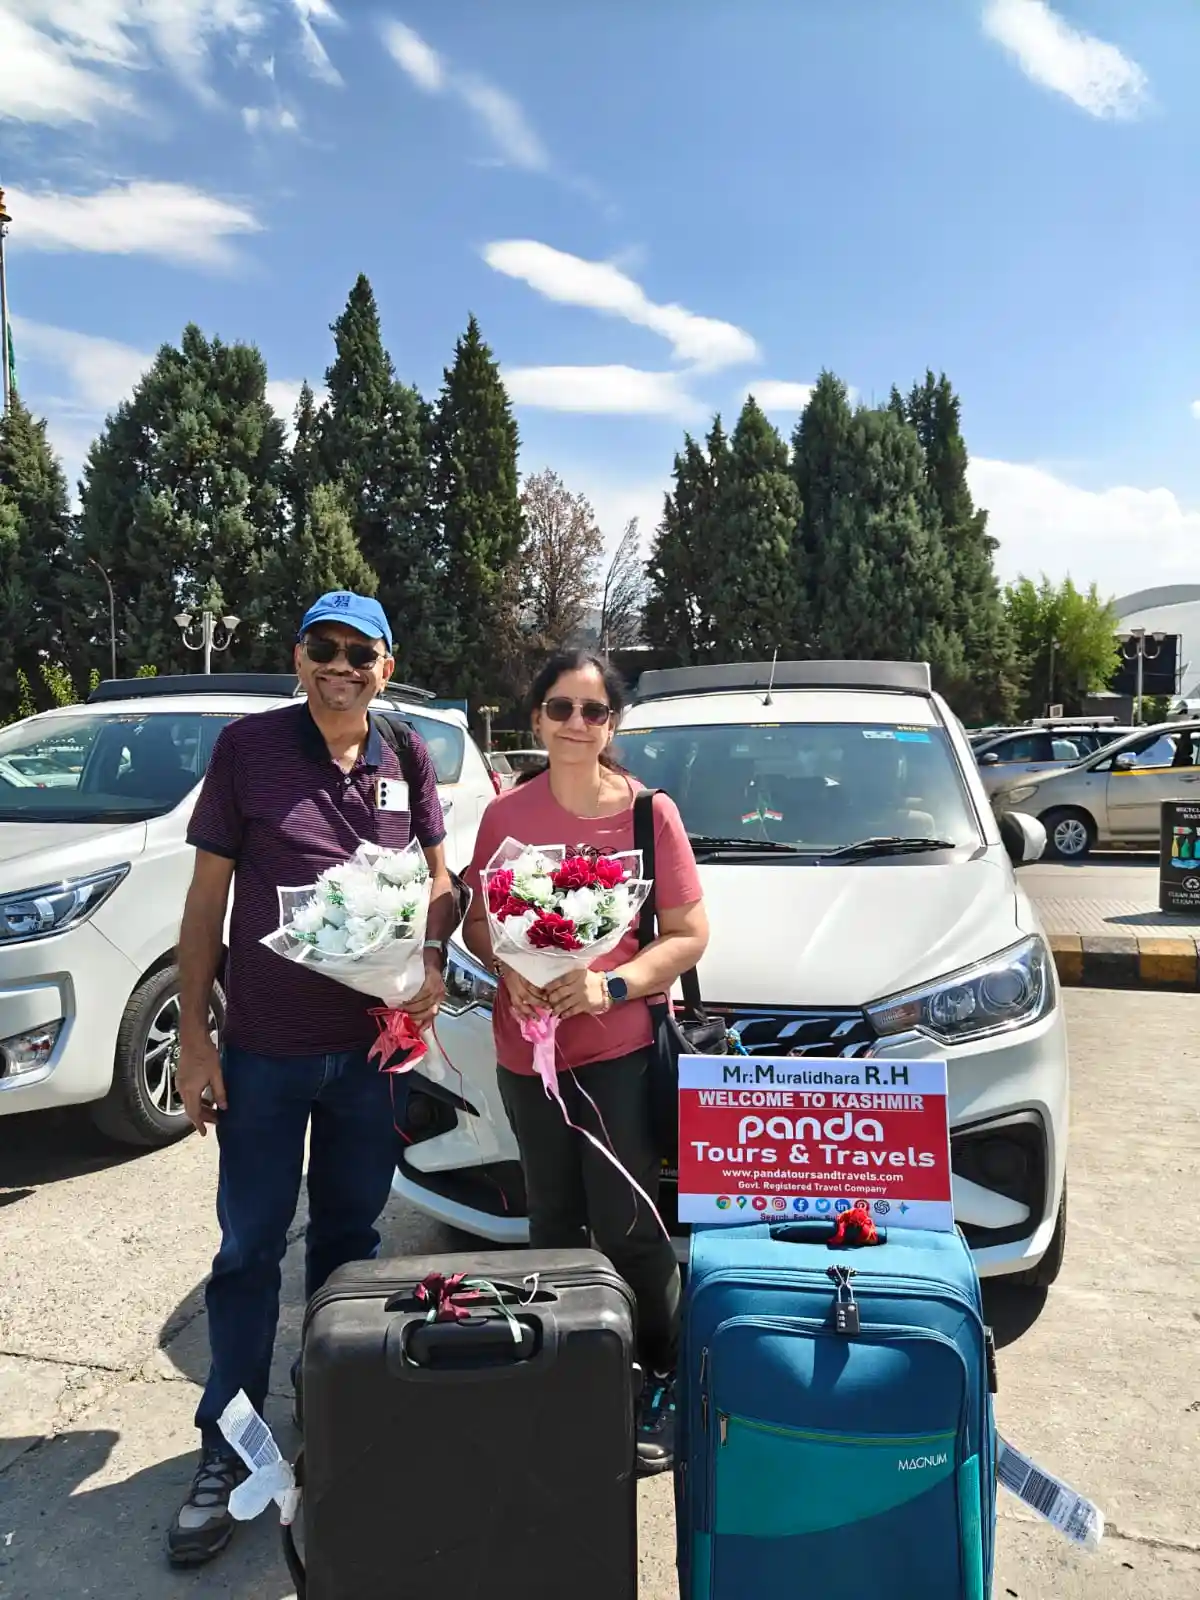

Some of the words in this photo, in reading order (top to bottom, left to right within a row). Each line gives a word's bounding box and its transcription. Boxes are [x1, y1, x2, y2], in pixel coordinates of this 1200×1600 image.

[864, 1065, 909, 1085] R.H
[698, 1090, 793, 1107] WELCOME
[800, 1092, 826, 1108] TO
[832, 1094, 924, 1111] KASHMIR
[738, 1112, 884, 1145] panda
[690, 1141, 778, 1163] Tours
[789, 1144, 810, 1165] &
[818, 1145, 936, 1168] Travels
[722, 1168, 904, 1182] www.pandatoursandtravels.com
[738, 1181, 761, 1190] Govt.
[763, 1181, 812, 1192] Registered
[814, 1183, 842, 1193] Travel
[844, 1184, 887, 1195] Company
[898, 1453, 947, 1471] MAGNUM
